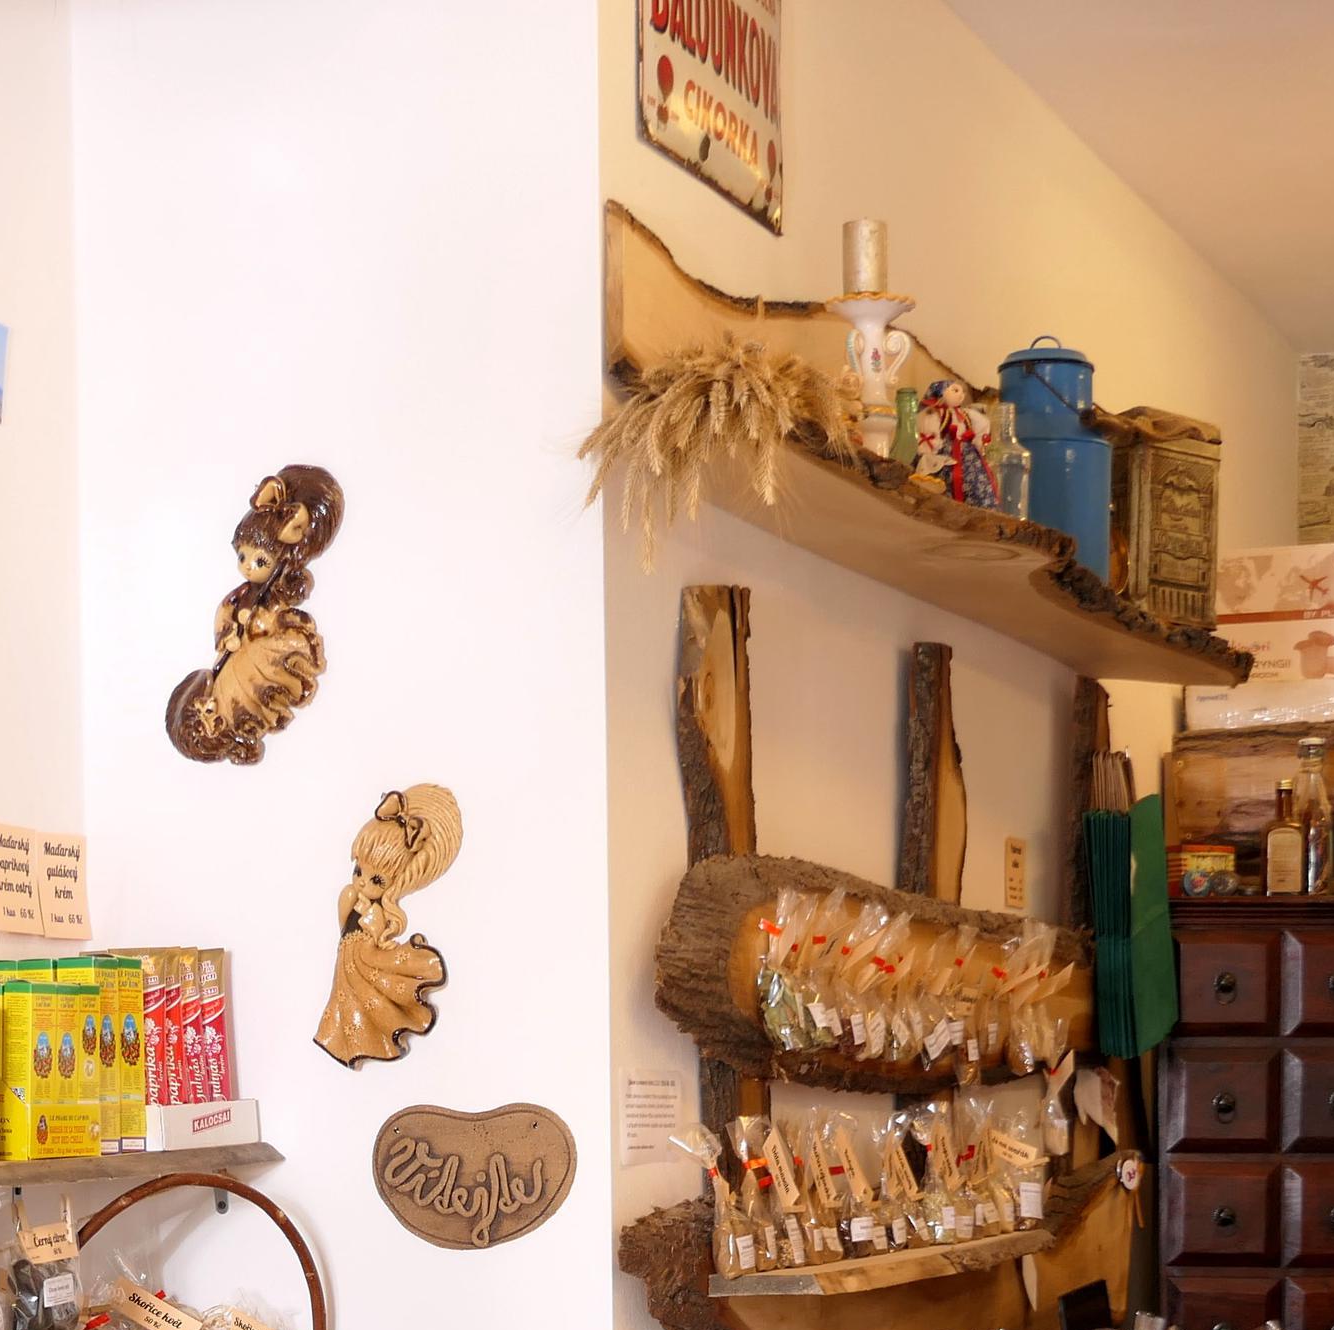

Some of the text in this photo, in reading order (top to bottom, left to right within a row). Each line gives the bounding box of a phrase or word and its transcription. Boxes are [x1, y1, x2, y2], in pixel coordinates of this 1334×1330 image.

[684, 79, 759, 167] CIKORKA
[43, 841, 81, 863] Maďarský
[46, 865, 79, 883] gulášový
[15, 881, 33, 898] ostrý
[54, 885, 74, 901] krém
[192, 1109, 231, 1133] KALOCSAI
[33, 1233, 53, 1250] Černý
[128, 1292, 183, 1330] Skořice květ
